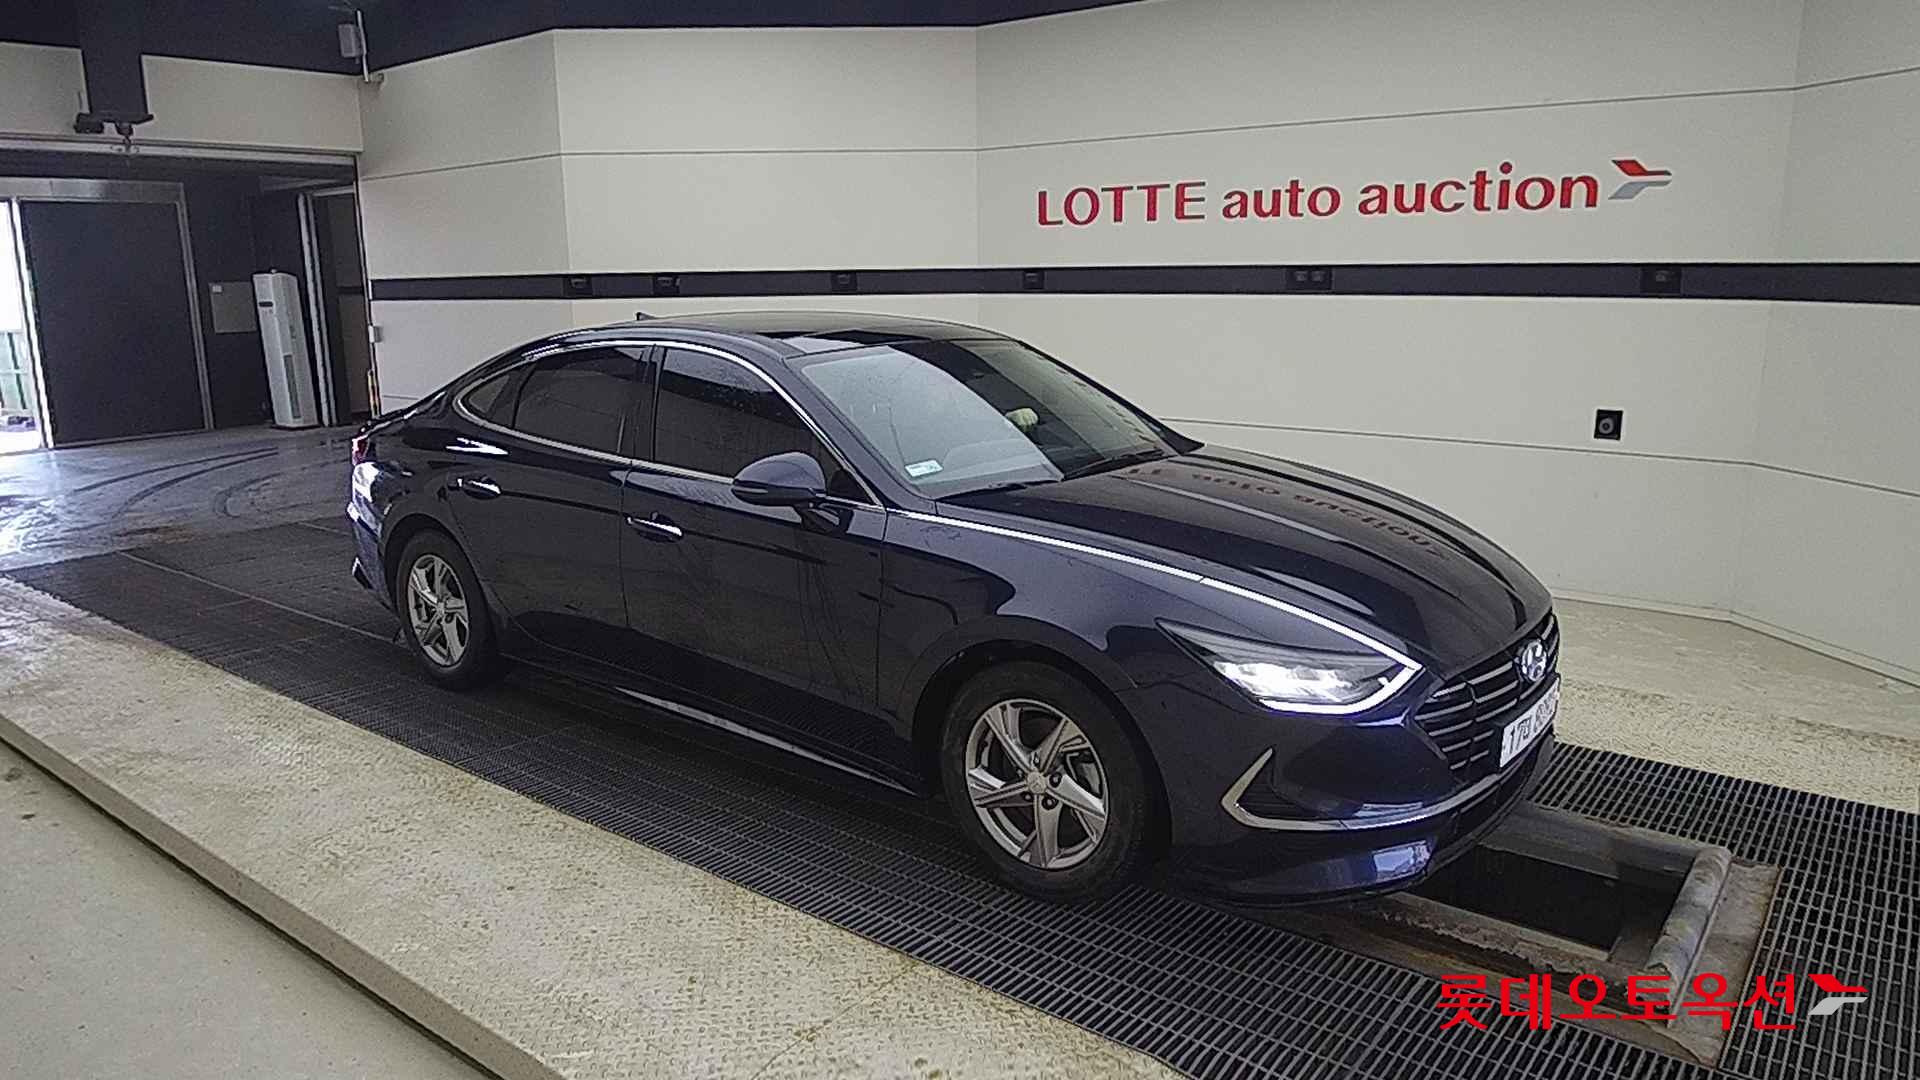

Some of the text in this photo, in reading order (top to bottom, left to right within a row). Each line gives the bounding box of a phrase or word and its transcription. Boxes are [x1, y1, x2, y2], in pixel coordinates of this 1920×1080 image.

[1037, 161, 1600, 226] LOTTE auto auction
